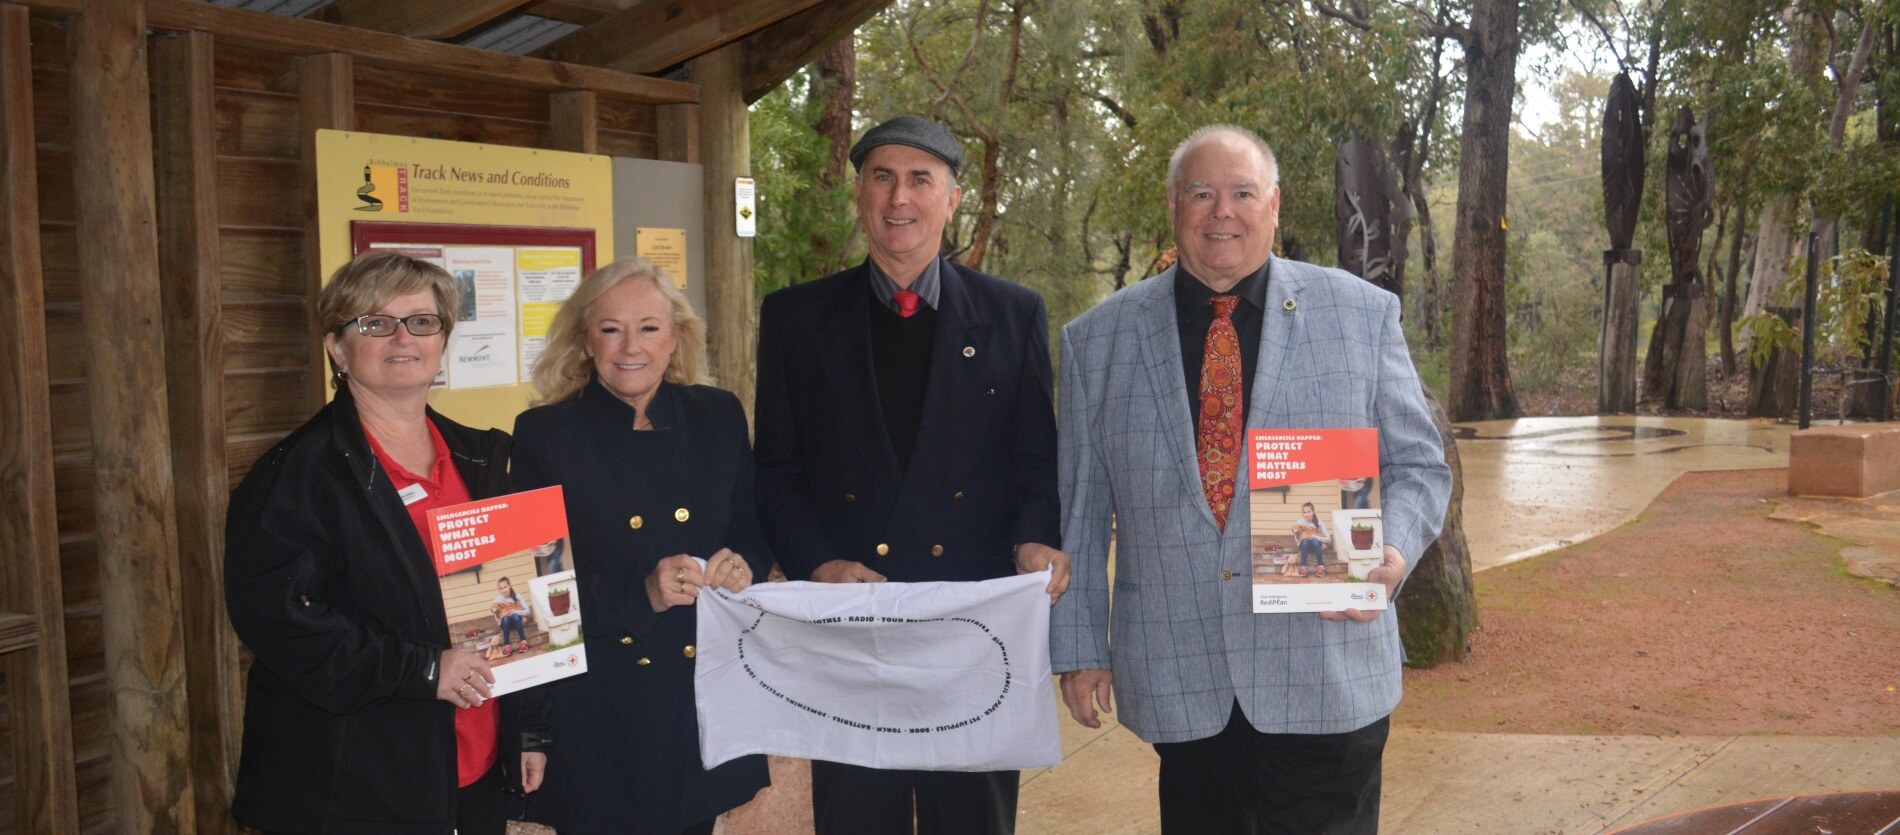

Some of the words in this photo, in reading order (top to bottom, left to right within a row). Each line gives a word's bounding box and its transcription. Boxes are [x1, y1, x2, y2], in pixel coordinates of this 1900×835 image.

[412, 164, 446, 180] Track
[450, 167, 484, 183] News
[487, 169, 509, 184] and
[512, 171, 570, 189] Conditions
[399, 168, 408, 212] TRACK
[1255, 442, 1302, 451] PROTECT
[1256, 452, 1289, 460] WHAT
[1256, 461, 1306, 470] MATTERS
[1257, 471, 1287, 480] MOST
[436, 508, 480, 521] EMERGENCIES
[438, 514, 489, 531] PROTECT
[440, 527, 475, 542] WHAT
[442, 534, 496, 552] MATTERS
[444, 549, 477, 563] MOST
[951, 617, 990, 633] TOILETRIES
[992, 636, 1009, 666] BLANKET
[743, 663, 756, 679] FOOD
[759, 680, 784, 699] SPECIAL
[1003, 671, 1011, 694] PENCIL
[785, 697, 827, 717] SOMETHING
[984, 699, 1002, 716] PAPER
[832, 716, 871, 730] BATTERIES
[936, 720, 968, 732] SUPPLIES
[969, 715, 981, 725] PET
[876, 726, 901, 734] TORCH
